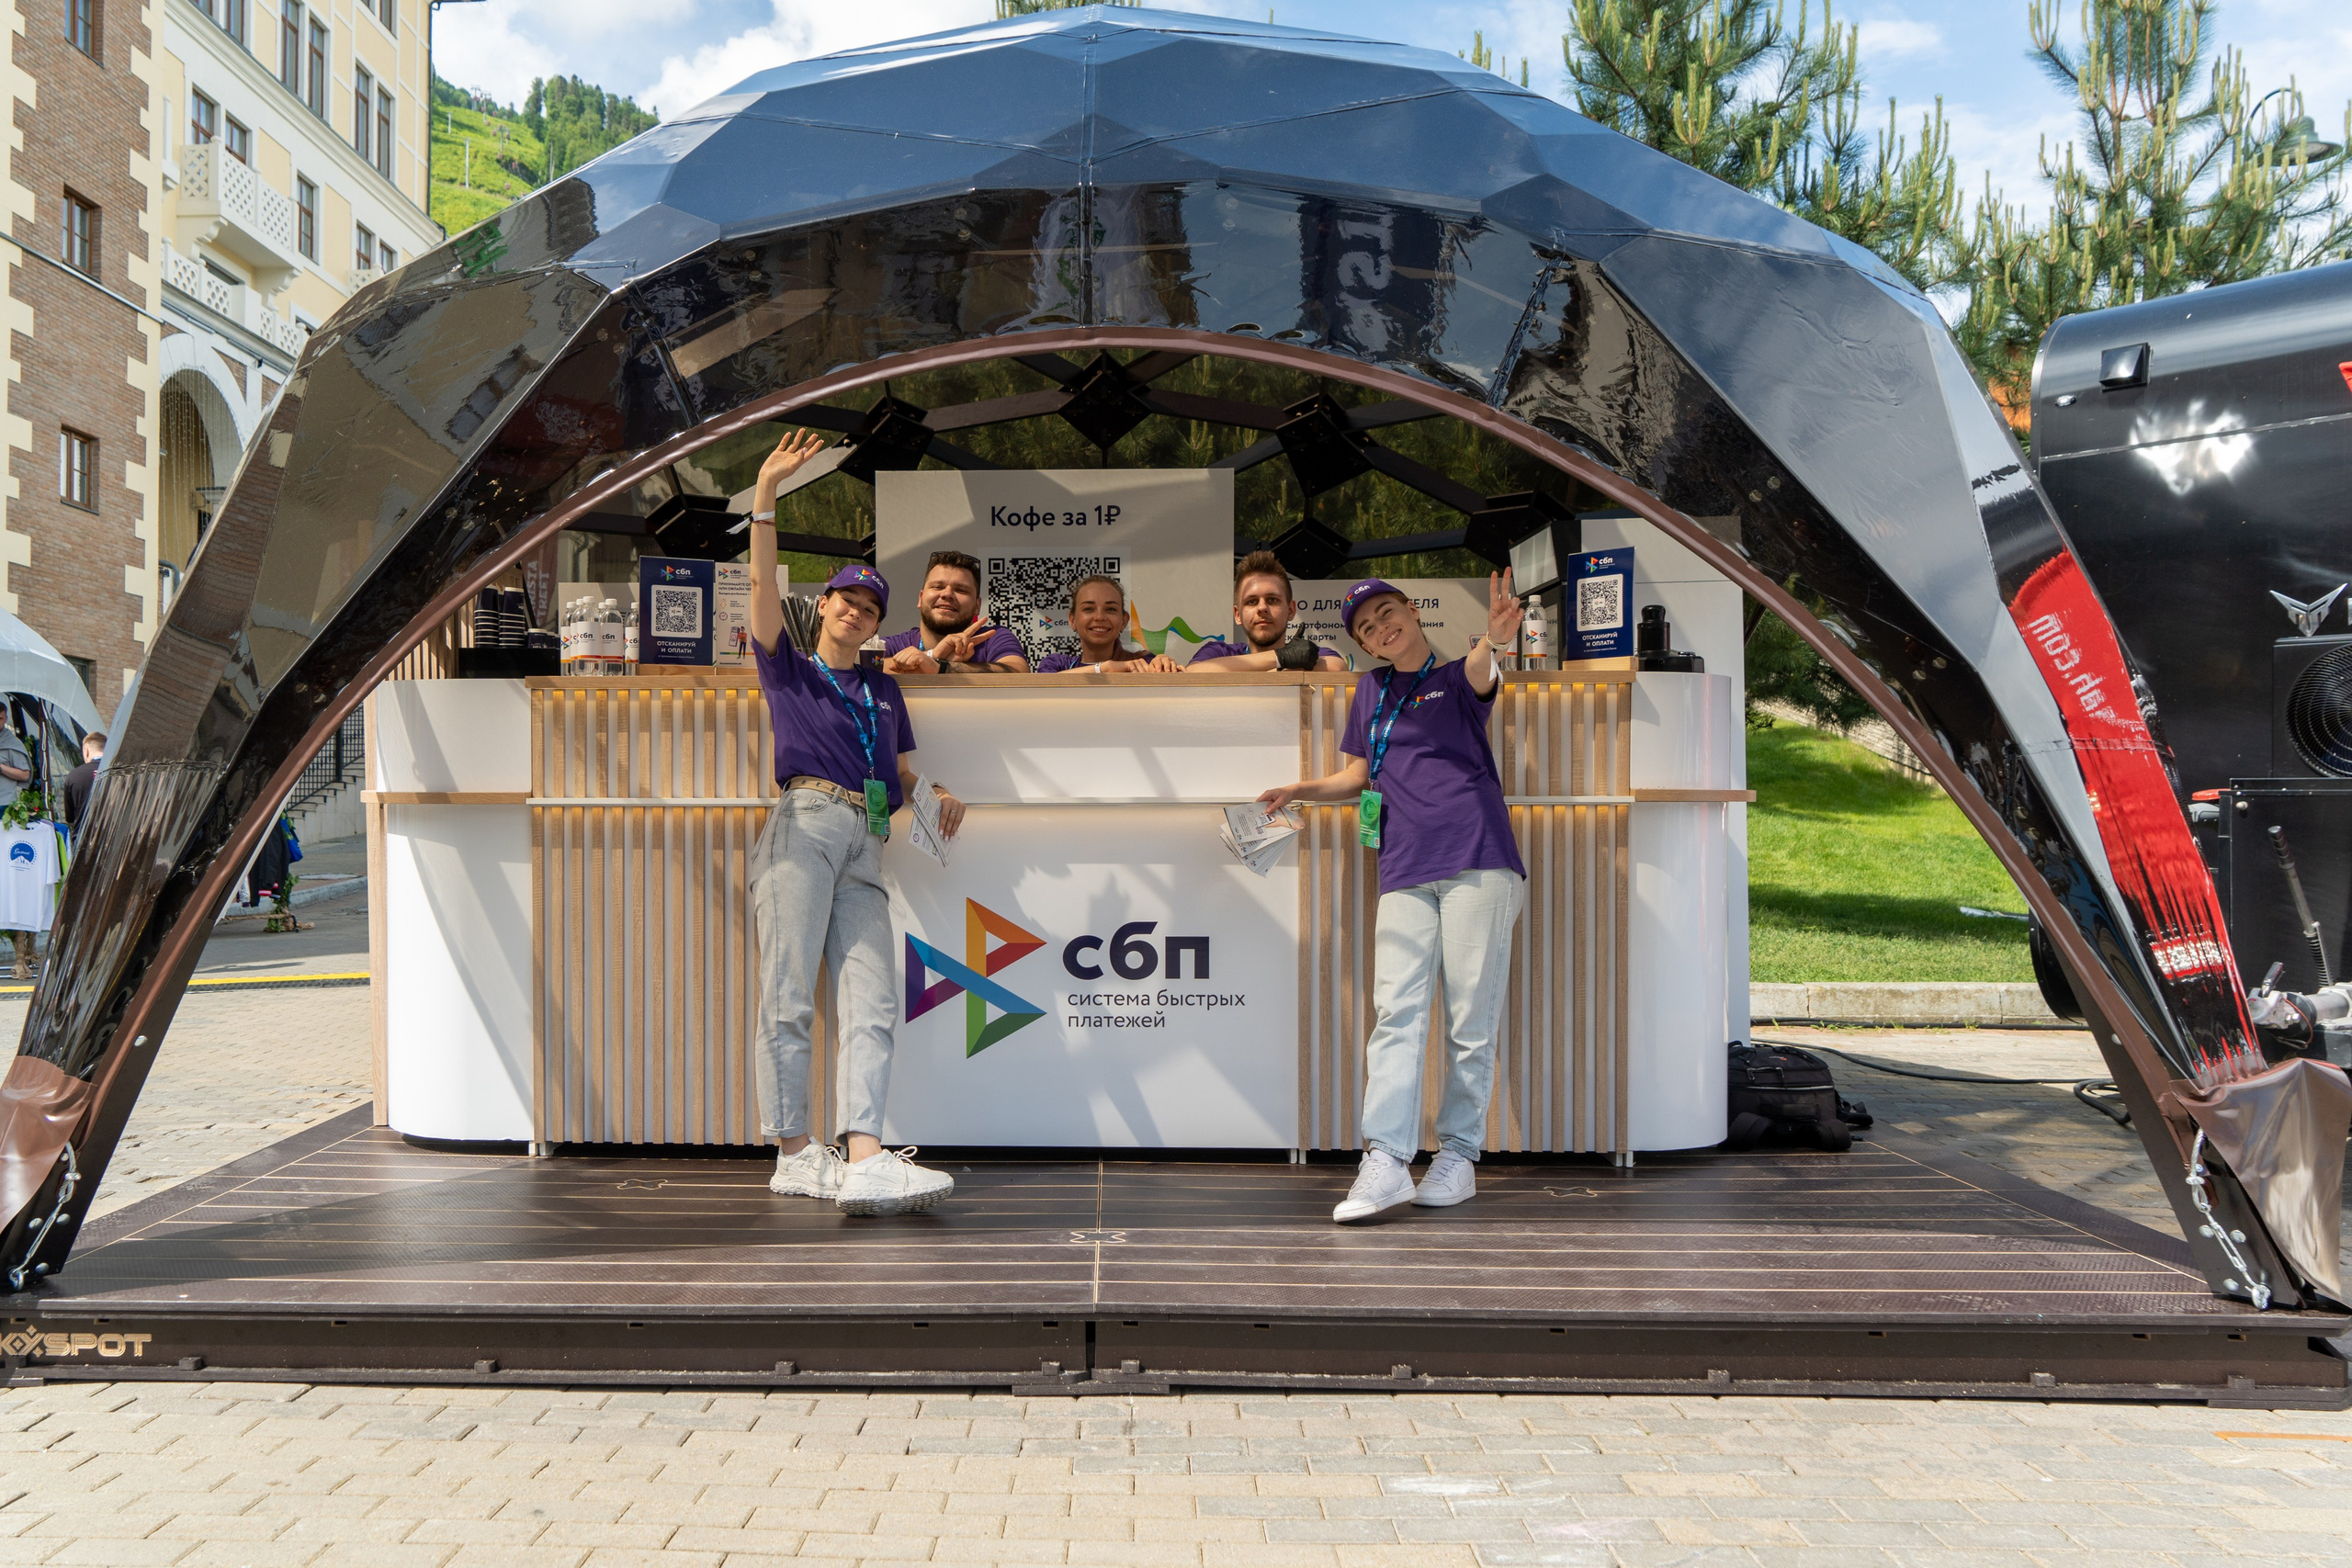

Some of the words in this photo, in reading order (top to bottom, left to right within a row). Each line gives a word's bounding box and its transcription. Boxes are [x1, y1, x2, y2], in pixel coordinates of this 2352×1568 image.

[990, 505, 1056, 532] Кофе
[1062, 511, 1087, 526] за
[1093, 504, 1122, 526] 1₽
[1599, 557, 1613, 565] сбп
[675, 568, 691, 576] сбп
[871, 575, 885, 589] сбп
[1354, 584, 1371, 595] сбп
[1312, 599, 1341, 612] ДЛЯ
[1307, 634, 1337, 642] карты
[1582, 631, 1618, 641] ОТСКАНИРУЙ
[1424, 690, 1444, 701] сбп
[1061, 919, 1210, 981] сбп
[1068, 992, 1150, 1007] система
[1157, 988, 1246, 1011] быстрых
[1068, 1011, 1166, 1029] платежей
